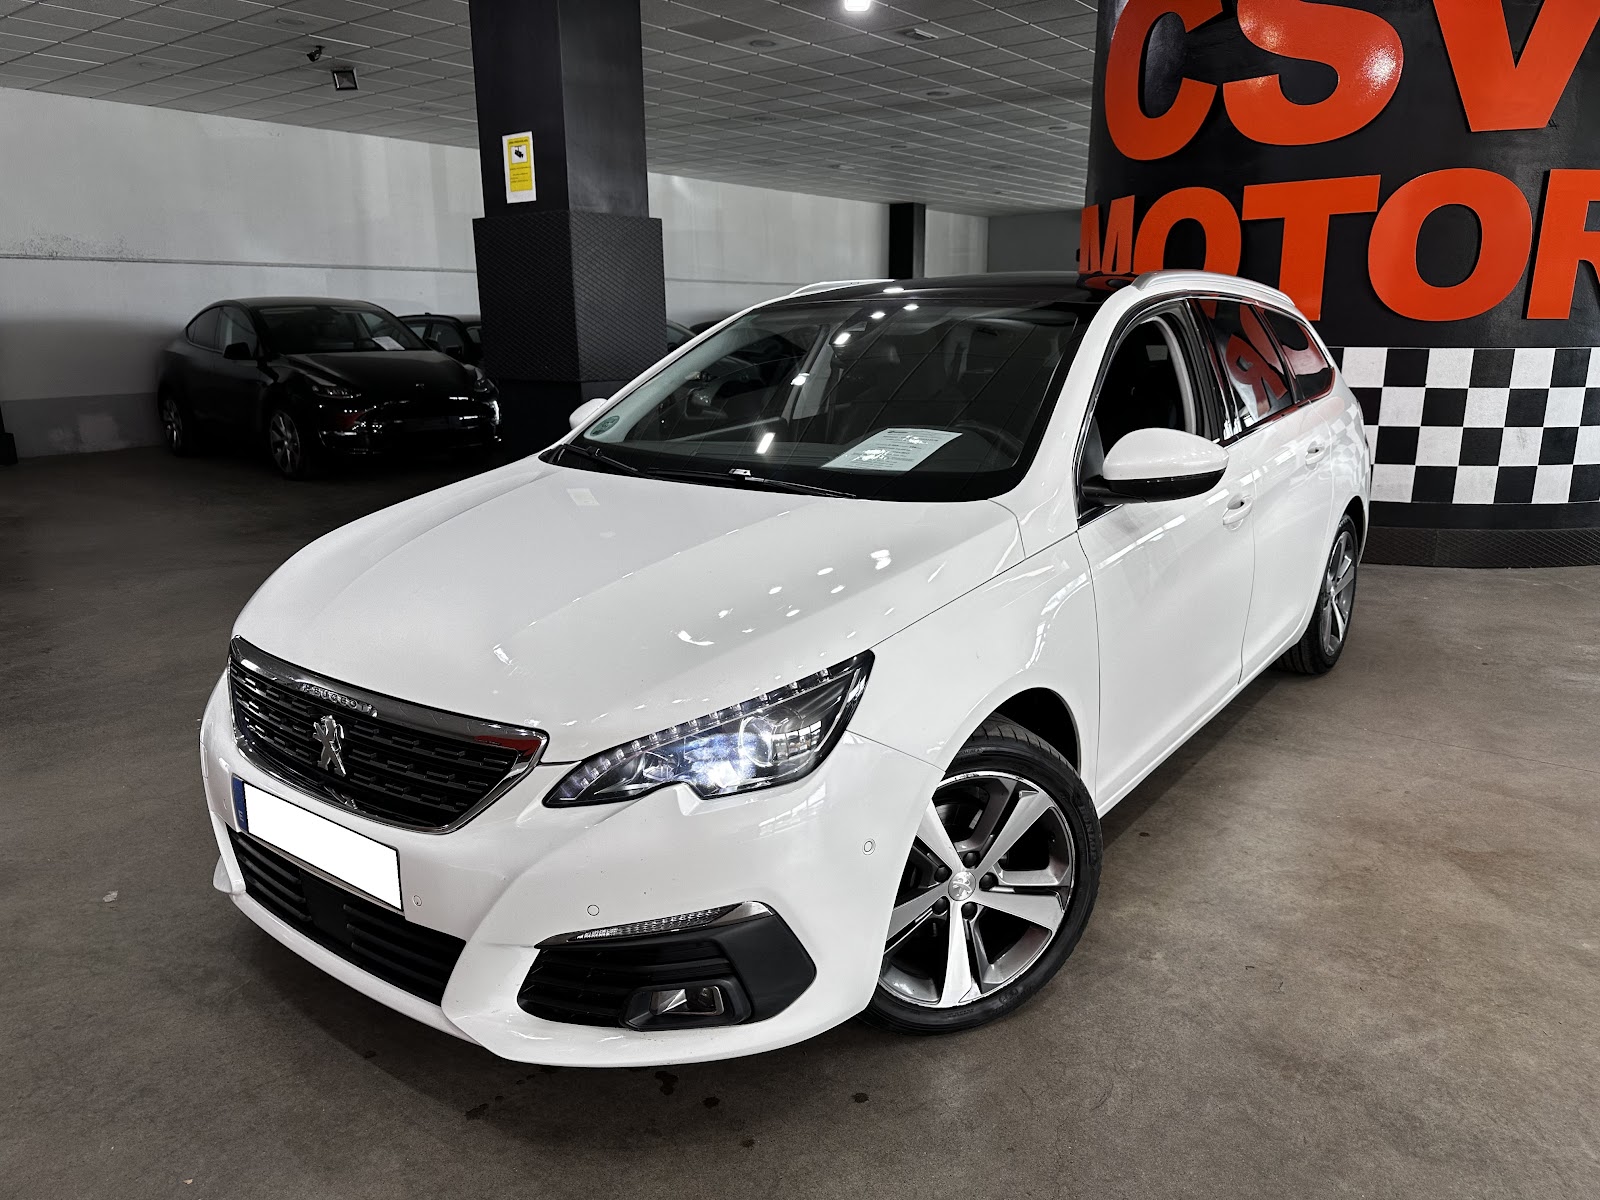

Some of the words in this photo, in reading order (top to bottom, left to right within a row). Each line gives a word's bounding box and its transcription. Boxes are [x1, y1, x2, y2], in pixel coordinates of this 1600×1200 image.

[1104, 0, 1600, 161] CSV
[301, 683, 373, 714] PEUGEOT
[1079, 805, 1098, 861] DUNLOP
